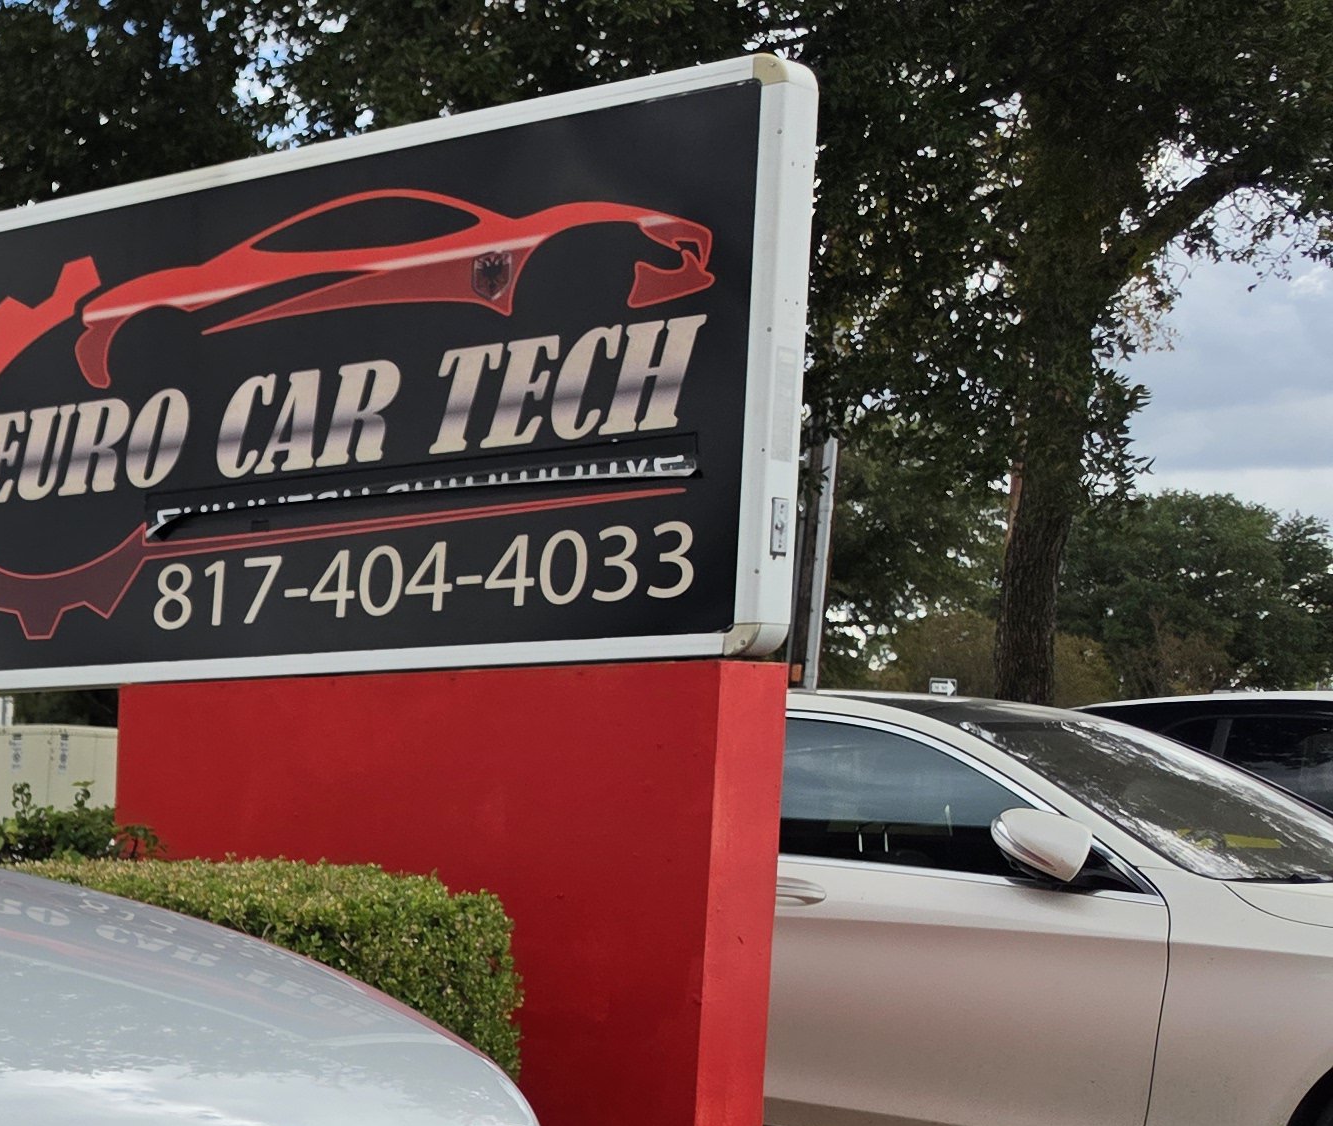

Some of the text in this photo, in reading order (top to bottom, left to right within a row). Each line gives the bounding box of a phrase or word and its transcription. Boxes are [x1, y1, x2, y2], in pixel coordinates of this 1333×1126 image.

[216, 358, 402, 481] CAR
[428, 313, 707, 455] TECH
[152, 519, 696, 632] 817-404-4033
